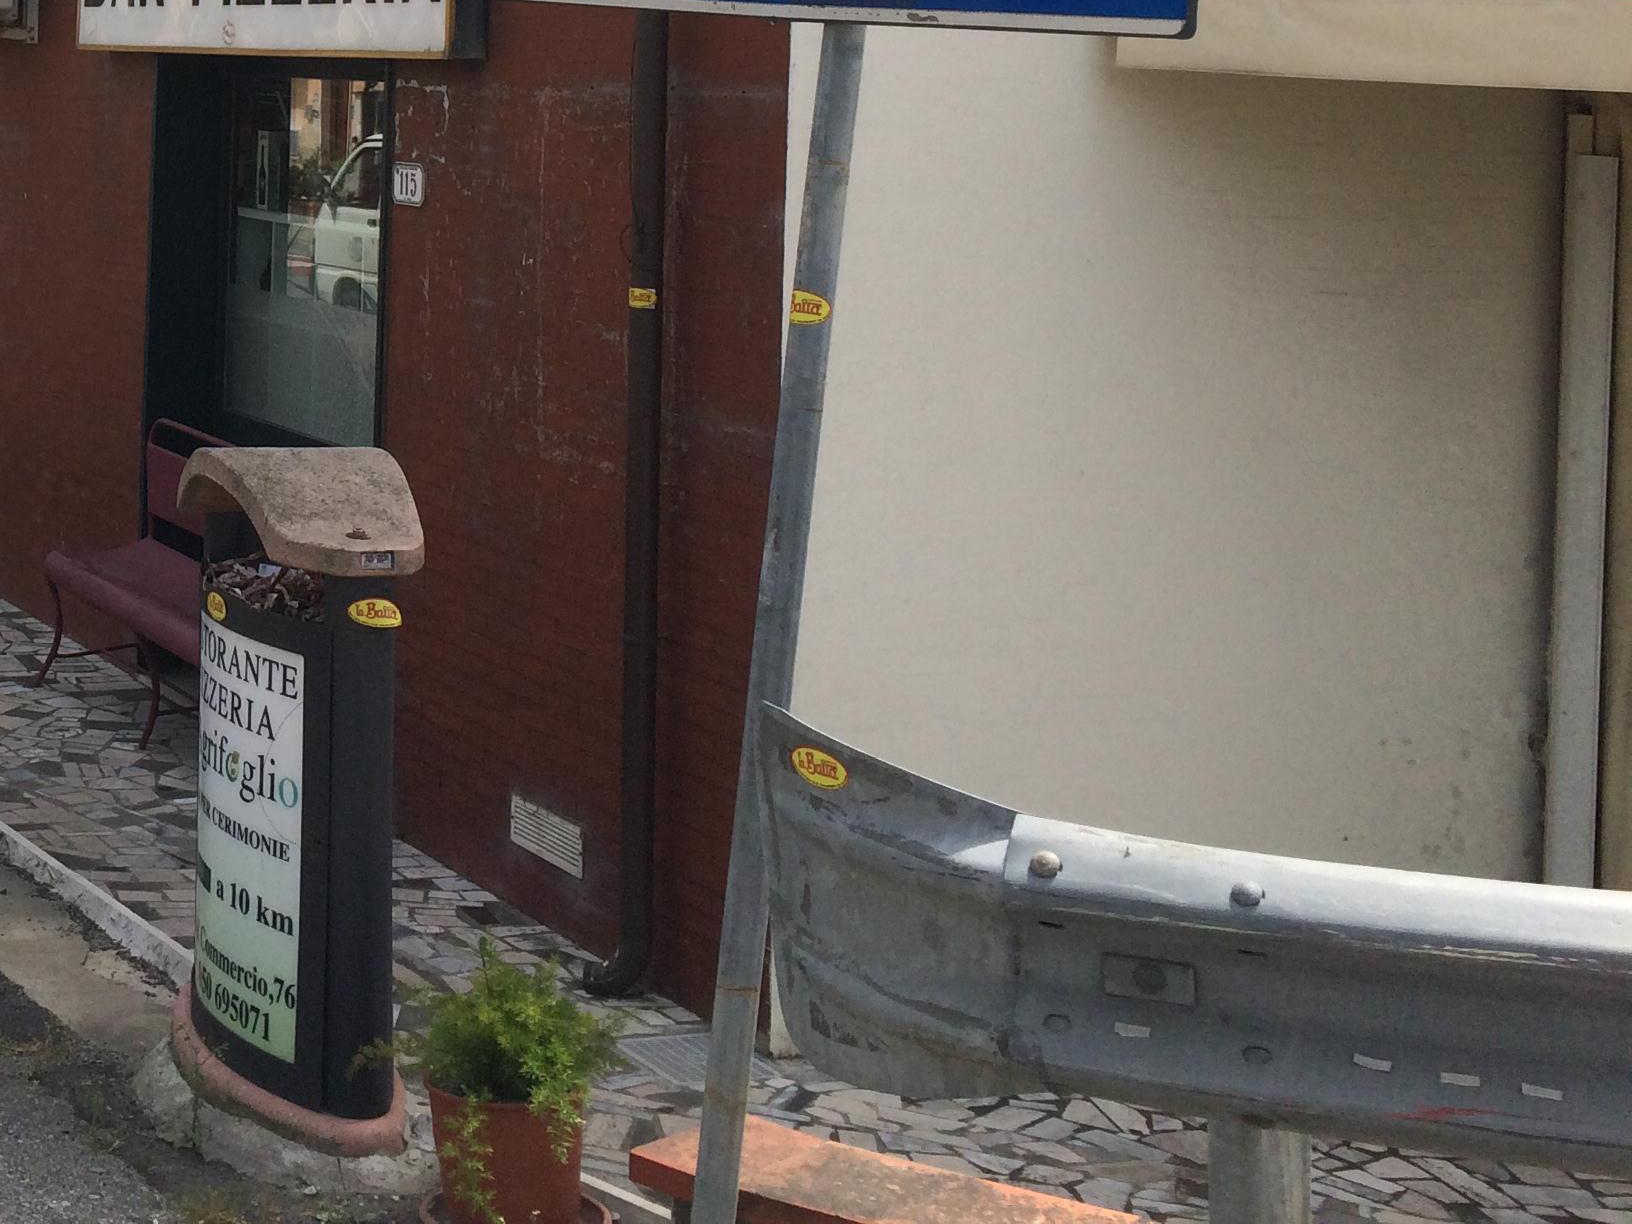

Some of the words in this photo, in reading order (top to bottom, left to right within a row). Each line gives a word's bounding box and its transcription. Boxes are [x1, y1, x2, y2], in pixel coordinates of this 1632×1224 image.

[399, 171, 417, 197] 115
[791, 299, 822, 316] aita
[201, 624, 298, 700] TORANTE
[202, 670, 275, 741] ZZERIA
[201, 729, 298, 808] grifoglio
[212, 806, 290, 863] CERIMONIE
[216, 879, 224, 901] a
[230, 882, 250, 916] 10
[256, 895, 294, 937] km
[199, 962, 212, 1001] 50
[215, 983, 271, 1043] 695071
